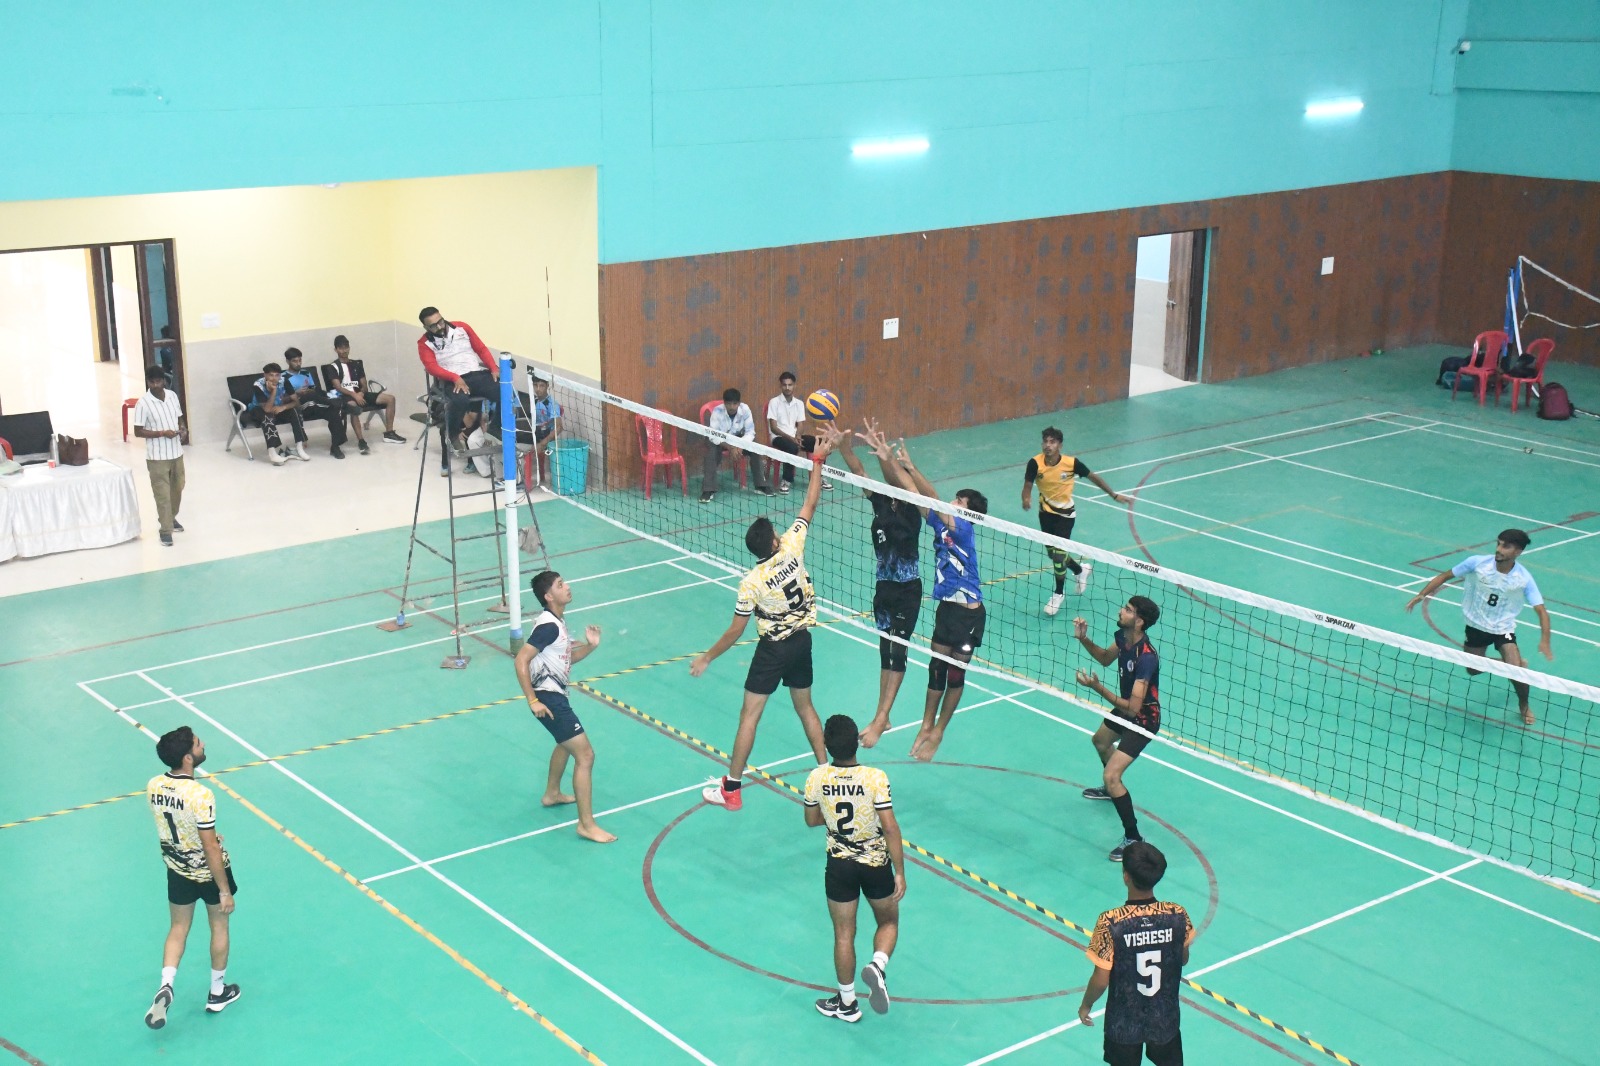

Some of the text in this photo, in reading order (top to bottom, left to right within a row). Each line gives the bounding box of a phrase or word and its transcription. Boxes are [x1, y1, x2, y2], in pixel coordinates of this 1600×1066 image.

[765, 557, 799, 590] MADHAV
[1133, 561, 1160, 573] SPARTAN
[782, 578, 804, 610] 5
[1487, 593, 1499, 607] 8
[1324, 615, 1356, 630] SPARTAN
[822, 784, 865, 796] SHIVA
[151, 794, 185, 810] ARYAN
[163, 811, 180, 845] 1
[835, 801, 854, 836] 2
[1123, 927, 1173, 948] VISHESH
[1136, 949, 1162, 997] 5
